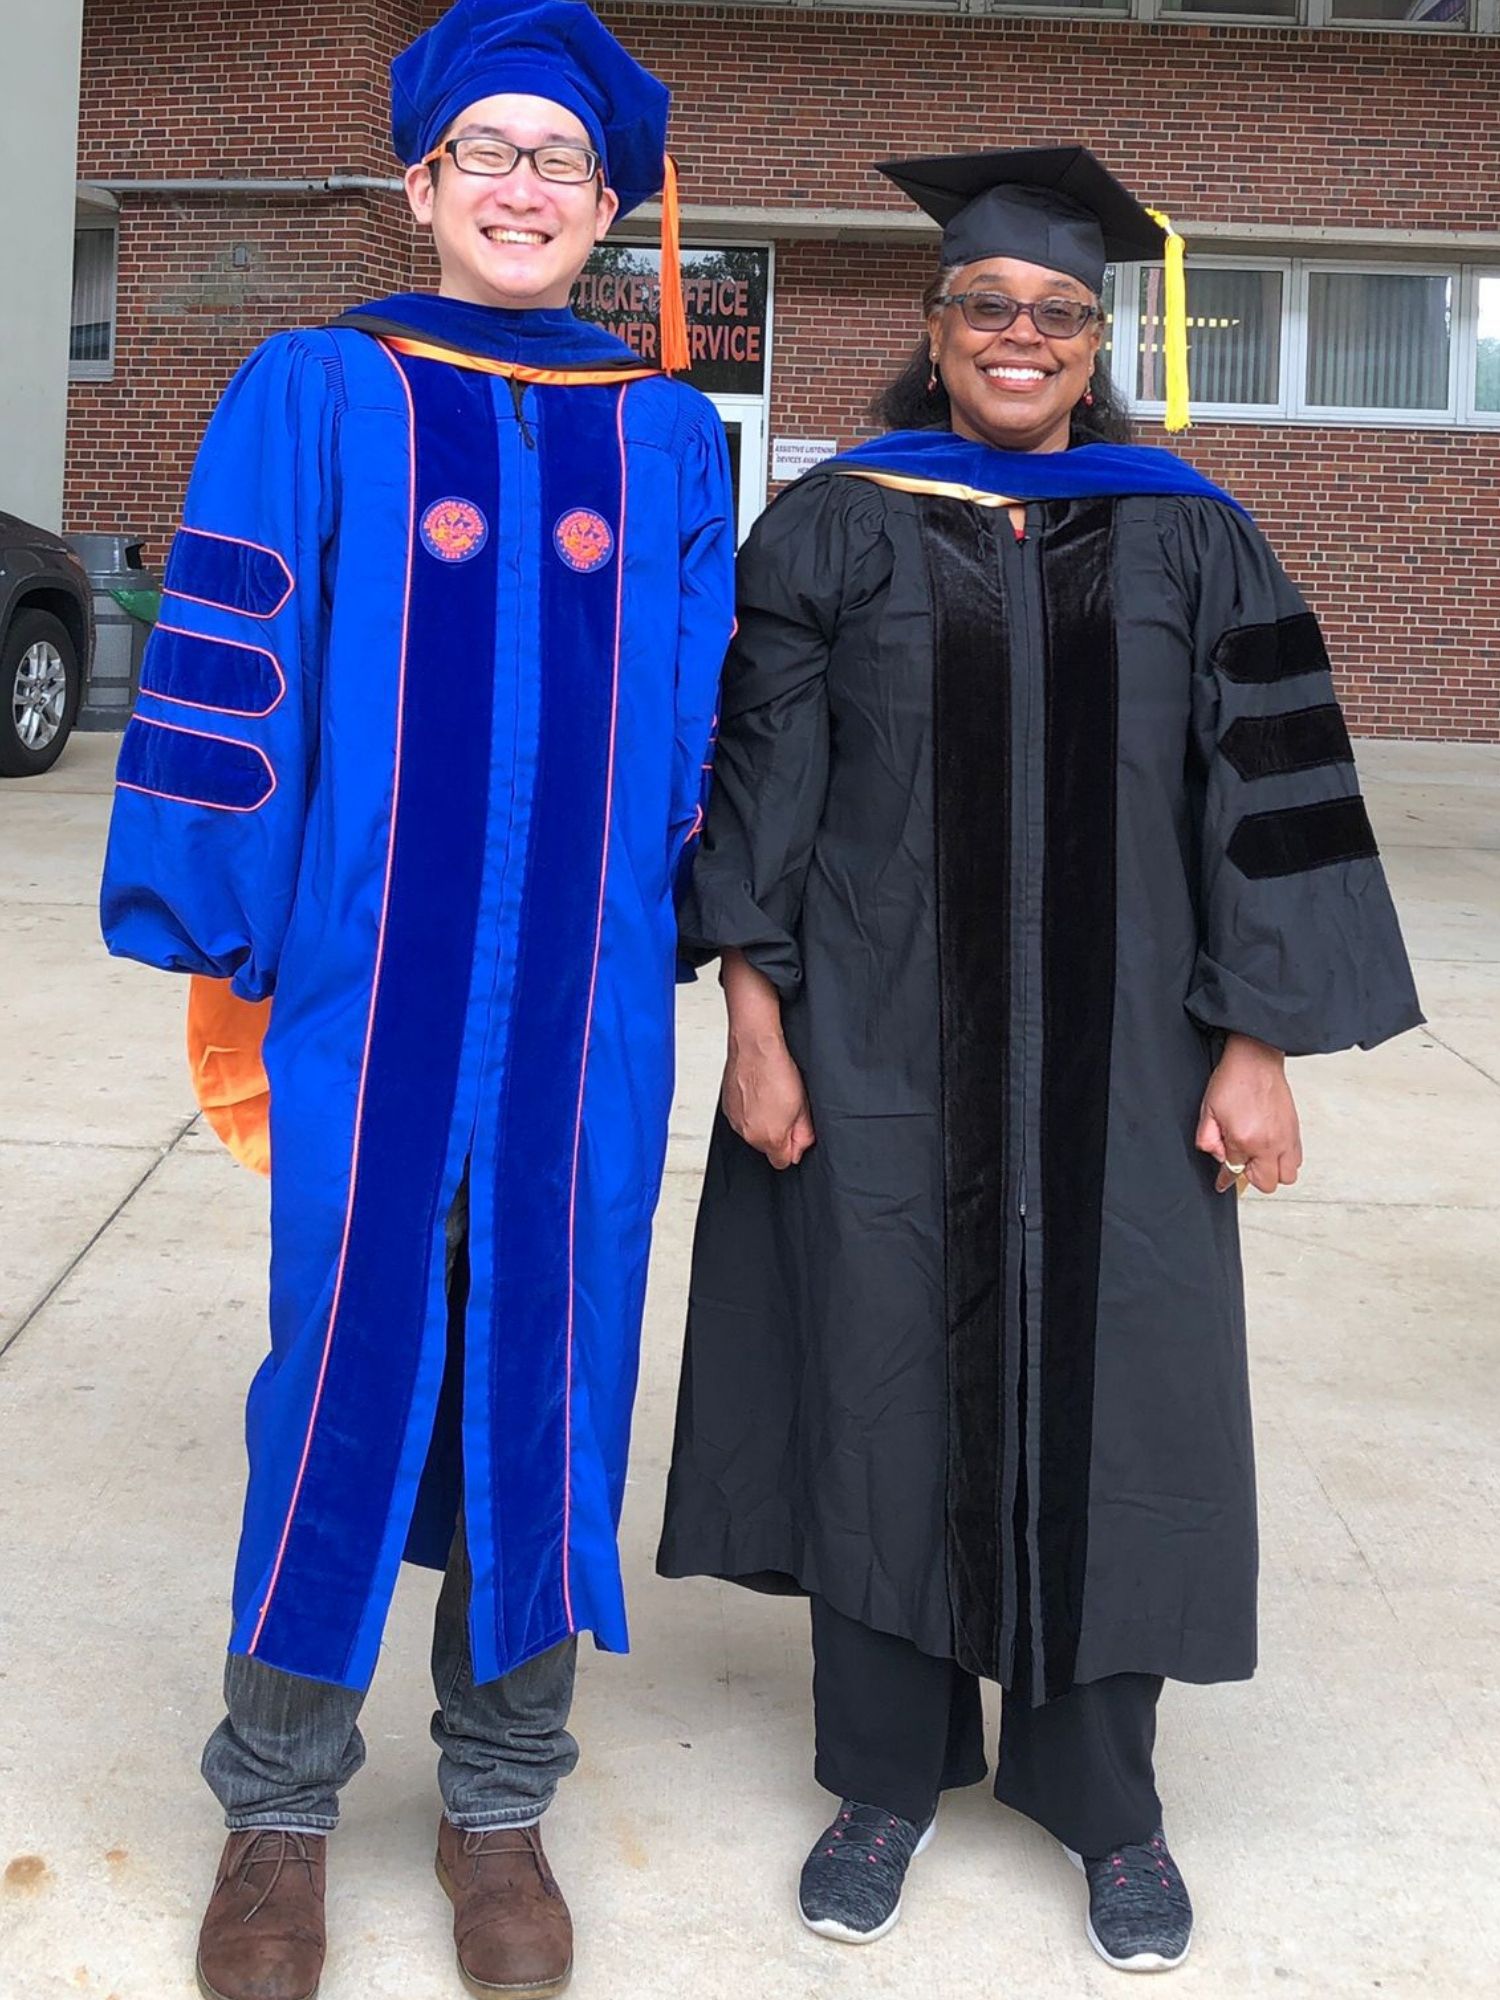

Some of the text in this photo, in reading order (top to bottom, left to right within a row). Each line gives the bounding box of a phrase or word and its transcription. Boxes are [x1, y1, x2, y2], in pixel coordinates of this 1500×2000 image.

[577, 273, 750, 316] TICKET FFICE
[685, 325, 761, 361] RVICE
